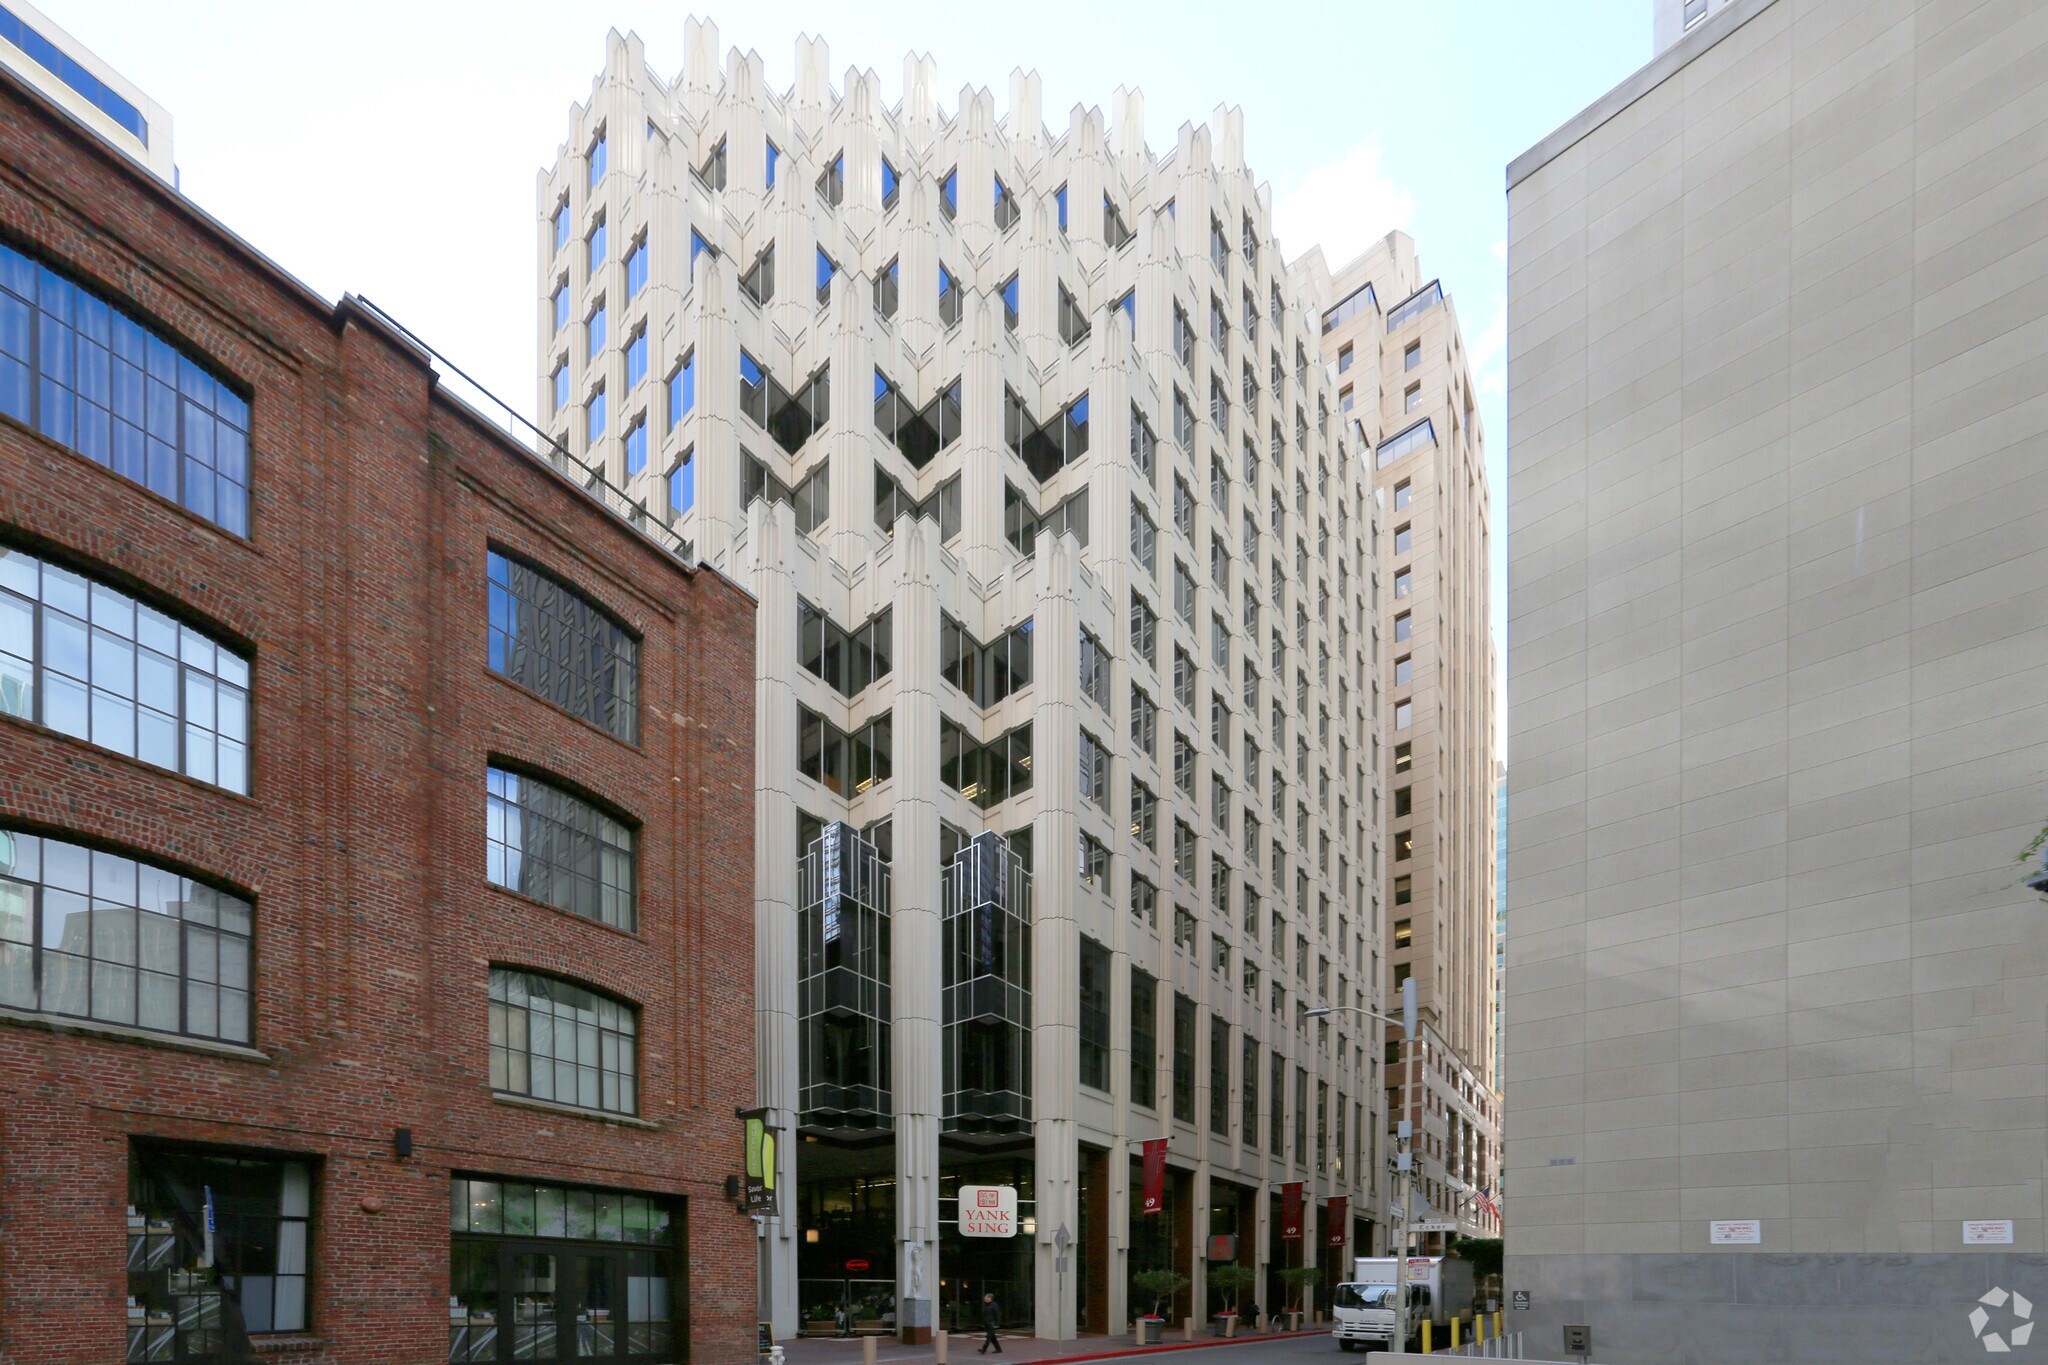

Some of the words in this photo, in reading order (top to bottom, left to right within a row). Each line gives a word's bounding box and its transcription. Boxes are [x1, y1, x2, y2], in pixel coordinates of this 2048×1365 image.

[747, 1185, 763, 1194] Savor
[750, 1194, 762, 1203] Life
[1145, 1197, 1155, 1207] 49
[966, 1209, 1010, 1221] YANK
[967, 1222, 1009, 1234] SING
[1286, 1226, 1297, 1234] 49
